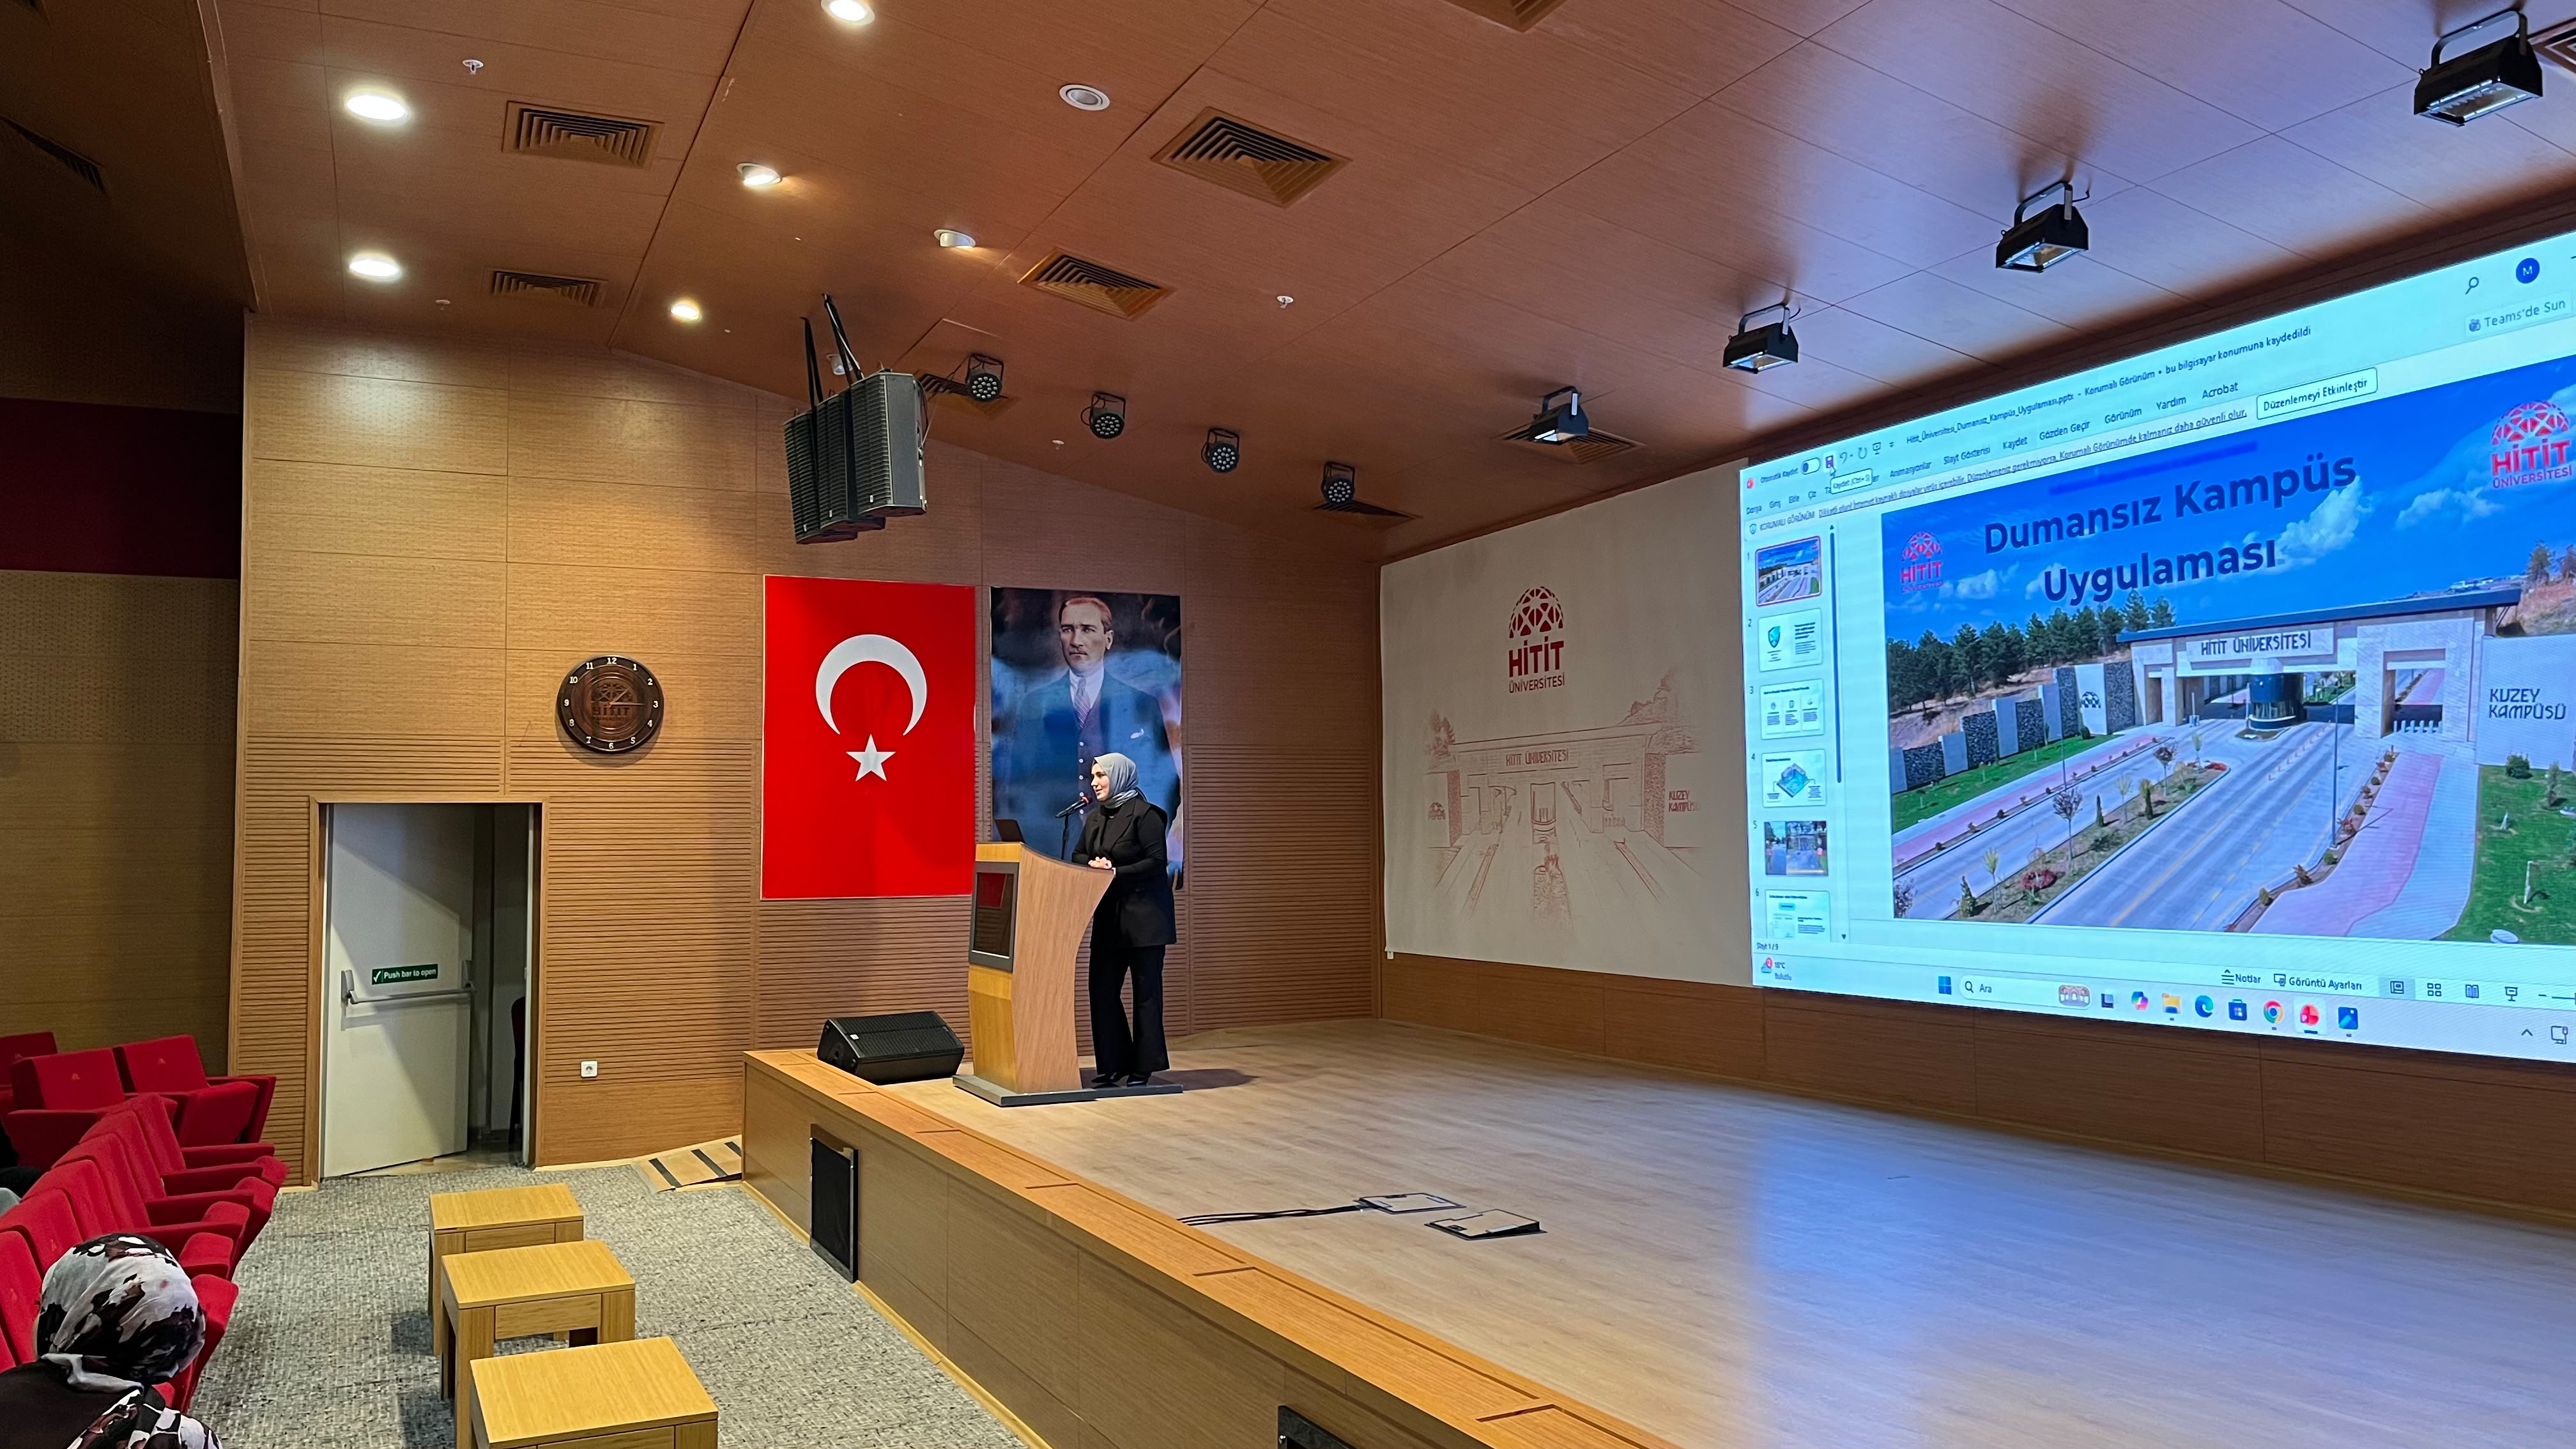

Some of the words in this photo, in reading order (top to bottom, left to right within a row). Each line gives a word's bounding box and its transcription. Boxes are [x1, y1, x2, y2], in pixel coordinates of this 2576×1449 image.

[2522, 265, 2533, 277] M
[2484, 305, 2540, 327] Teams'de
[2544, 300, 2566, 313] Sun
[2085, 380, 2117, 395] Korumalı
[2119, 371, 2155, 387] Görünüm
[2166, 365, 2176, 374] bu
[2178, 355, 2216, 371] bilgisayar
[2218, 341, 2264, 360] konumuna
[2266, 326, 2311, 346] kaydedildi
[2202, 382, 2238, 399] Acrobat
[2264, 388, 2320, 411] Düzenlemeyi
[2322, 378, 2367, 397] Etkinleştir
[2156, 397, 2186, 410] Yardım
[2104, 408, 2142, 424] Görünüm
[2138, 427, 2172, 441] kalmanız
[2175, 421, 2193, 433] daha
[2196, 411, 2226, 429] güvenli
[2228, 409, 2247, 420] olur.
[2039, 427, 2068, 440] Gözden
[2071, 420, 2090, 433] Geçir
[2003, 437, 2028, 450] Kaydet
[1943, 454, 1959, 464] Slayt
[1961, 445, 1990, 460] Gösterisi
[2492, 438, 2570, 476] HİTİT
[1890, 461, 1931, 477] Animasyonlar
[2492, 464, 2572, 489] ÜNİVERSİTESİ
[1984, 495, 2163, 555] Dumansız
[2175, 452, 2358, 518] Kampüs
[1901, 558, 1942, 584] HİTİT
[2044, 539, 2276, 606] Uygulaması
[2201, 639, 2227, 656] HİTİT
[2233, 631, 2311, 653] ÜNİVERSİTESİ
[1508, 636, 1565, 678] HİTİT
[1508, 672, 1565, 694] ÜNİVERSİTESİ
[2489, 688, 2541, 703] KUZEY
[2488, 703, 2566, 720] KAMPÜSÜ
[1668, 790, 1690, 801] KUZEY
[384, 971, 400, 979] Push
[2235, 974, 2261, 984] Notlar
[2288, 977, 2326, 988] Görüntü
[2328, 979, 2362, 990] Ayarları
[1979, 984, 1992, 993] Ara
